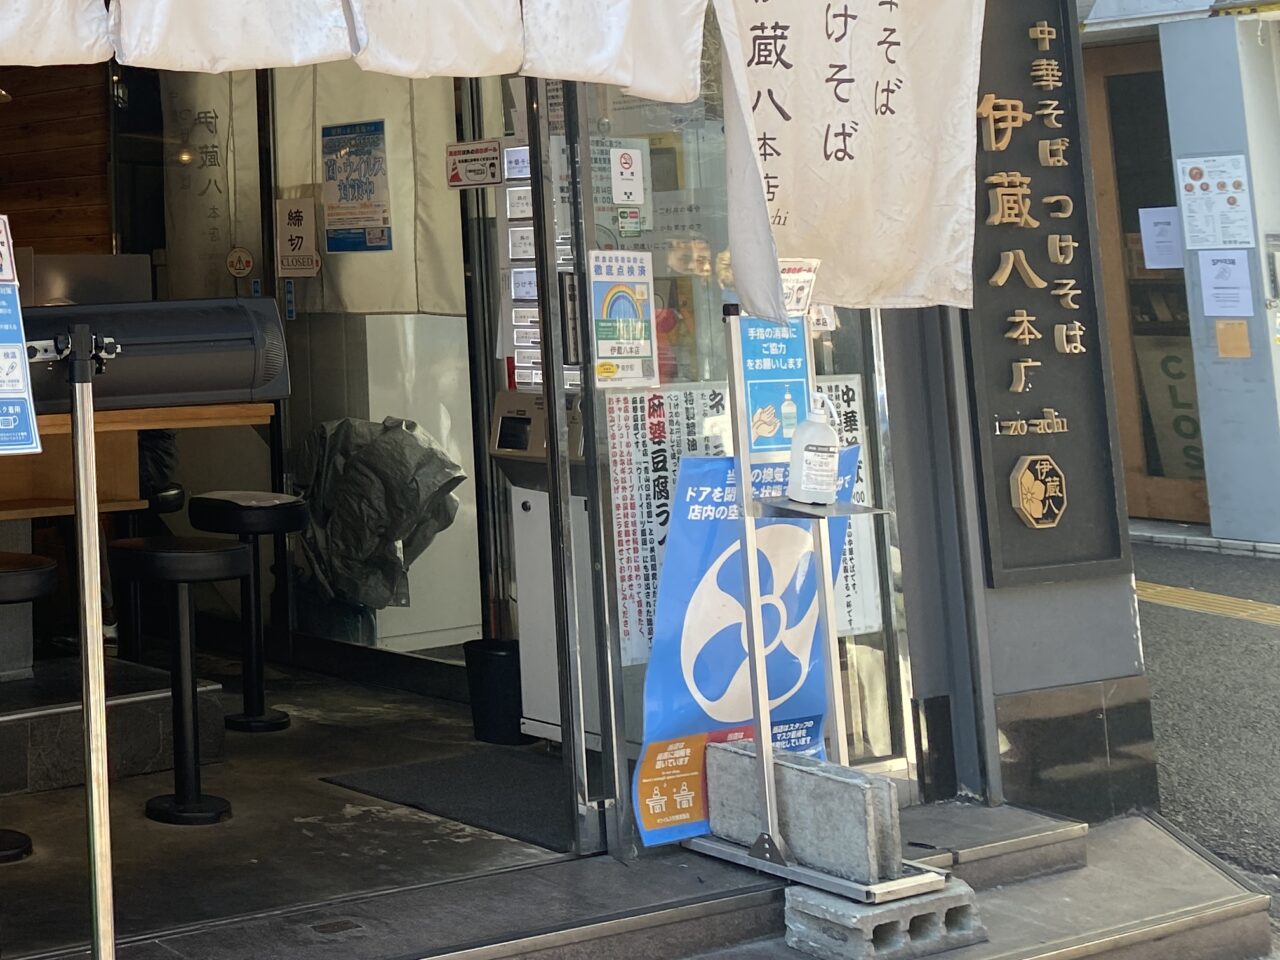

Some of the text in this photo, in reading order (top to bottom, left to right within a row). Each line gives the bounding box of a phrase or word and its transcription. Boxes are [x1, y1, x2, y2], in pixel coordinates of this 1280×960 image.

[1029, 20, 1087, 355] 中華そば つけそば
[287, 209, 303, 251] 締切
[281, 257, 313, 267] CLOSED
[748, 328, 797, 340] 手指の消毒に
[761, 343, 786, 355] ご協力
[747, 358, 803, 370] をお願いします
[1035, 460, 1063, 515] 伊蔵八
